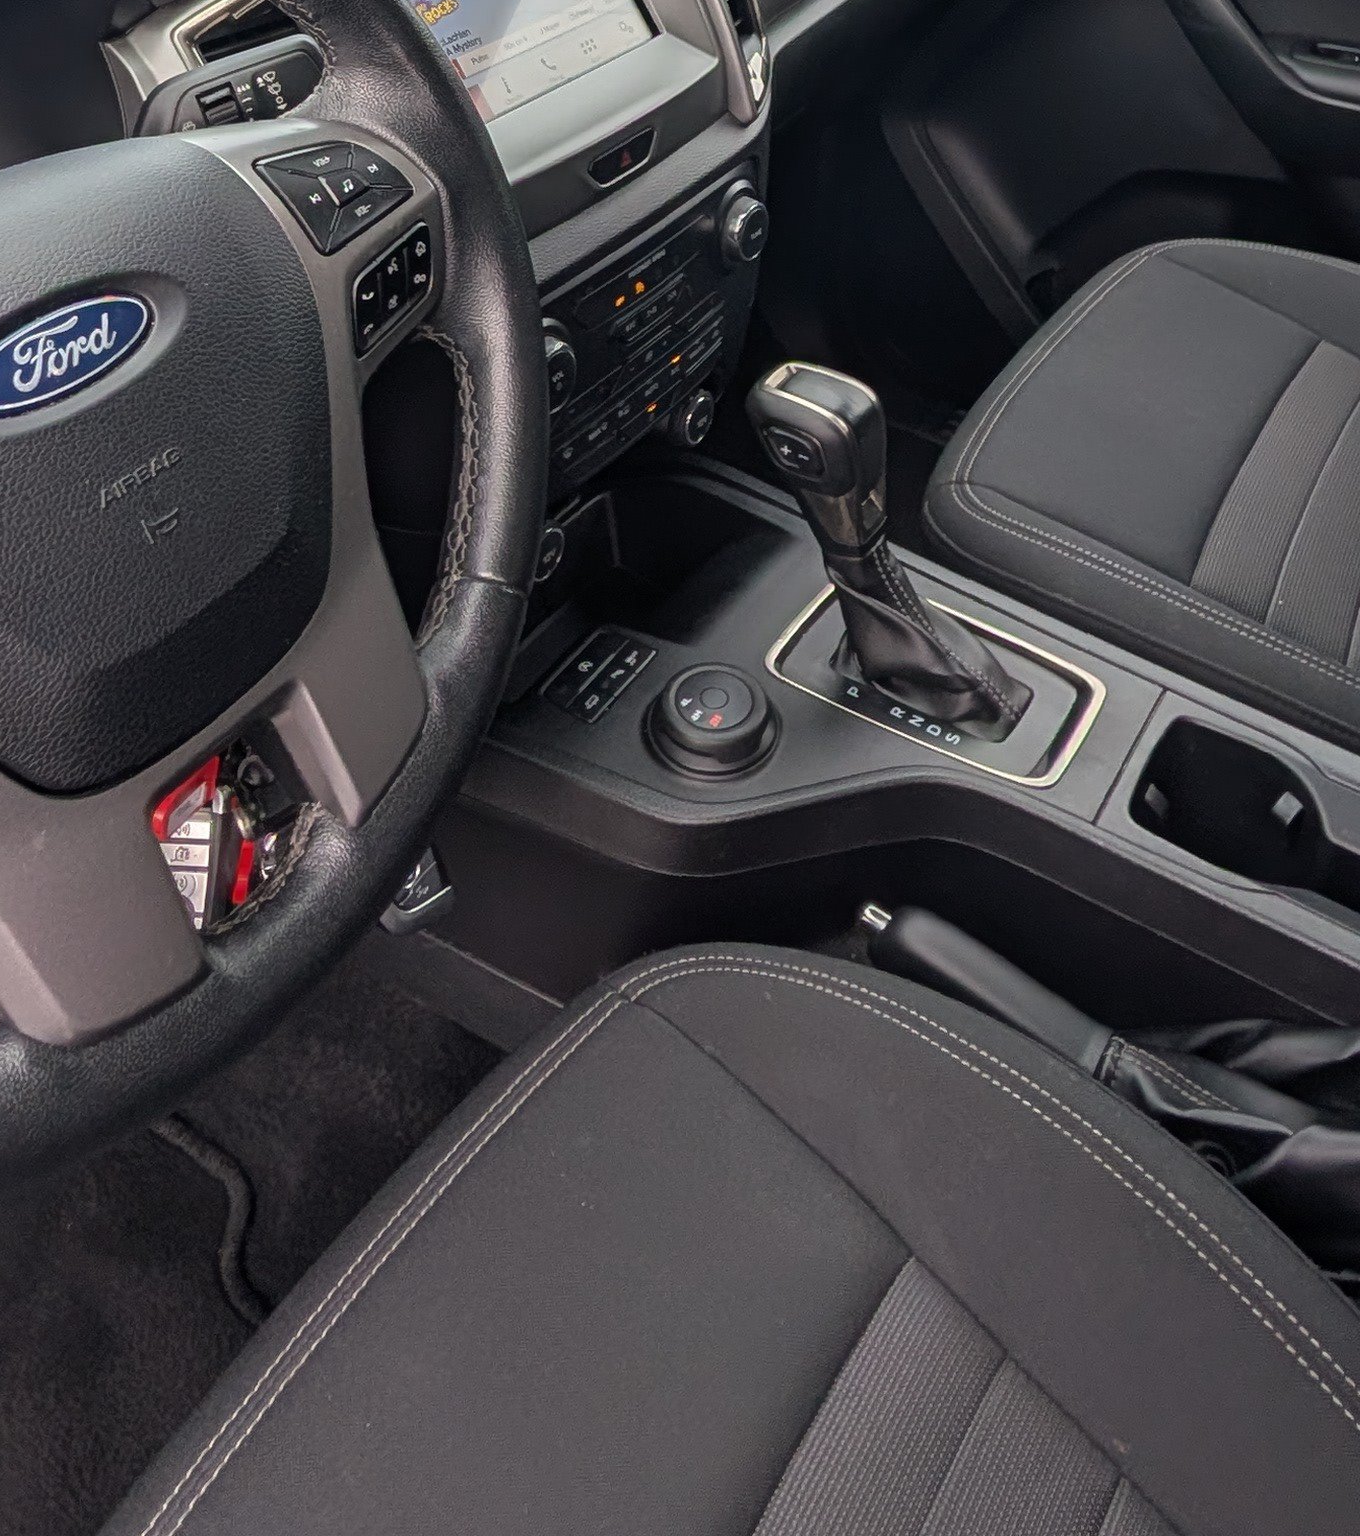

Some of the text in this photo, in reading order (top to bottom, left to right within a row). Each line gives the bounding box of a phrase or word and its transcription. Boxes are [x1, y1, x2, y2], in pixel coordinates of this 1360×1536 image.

[454, 36, 482, 55] Mystery
[12, 312, 117, 392] Ford
[846, 685, 961, 746] P R N D S
